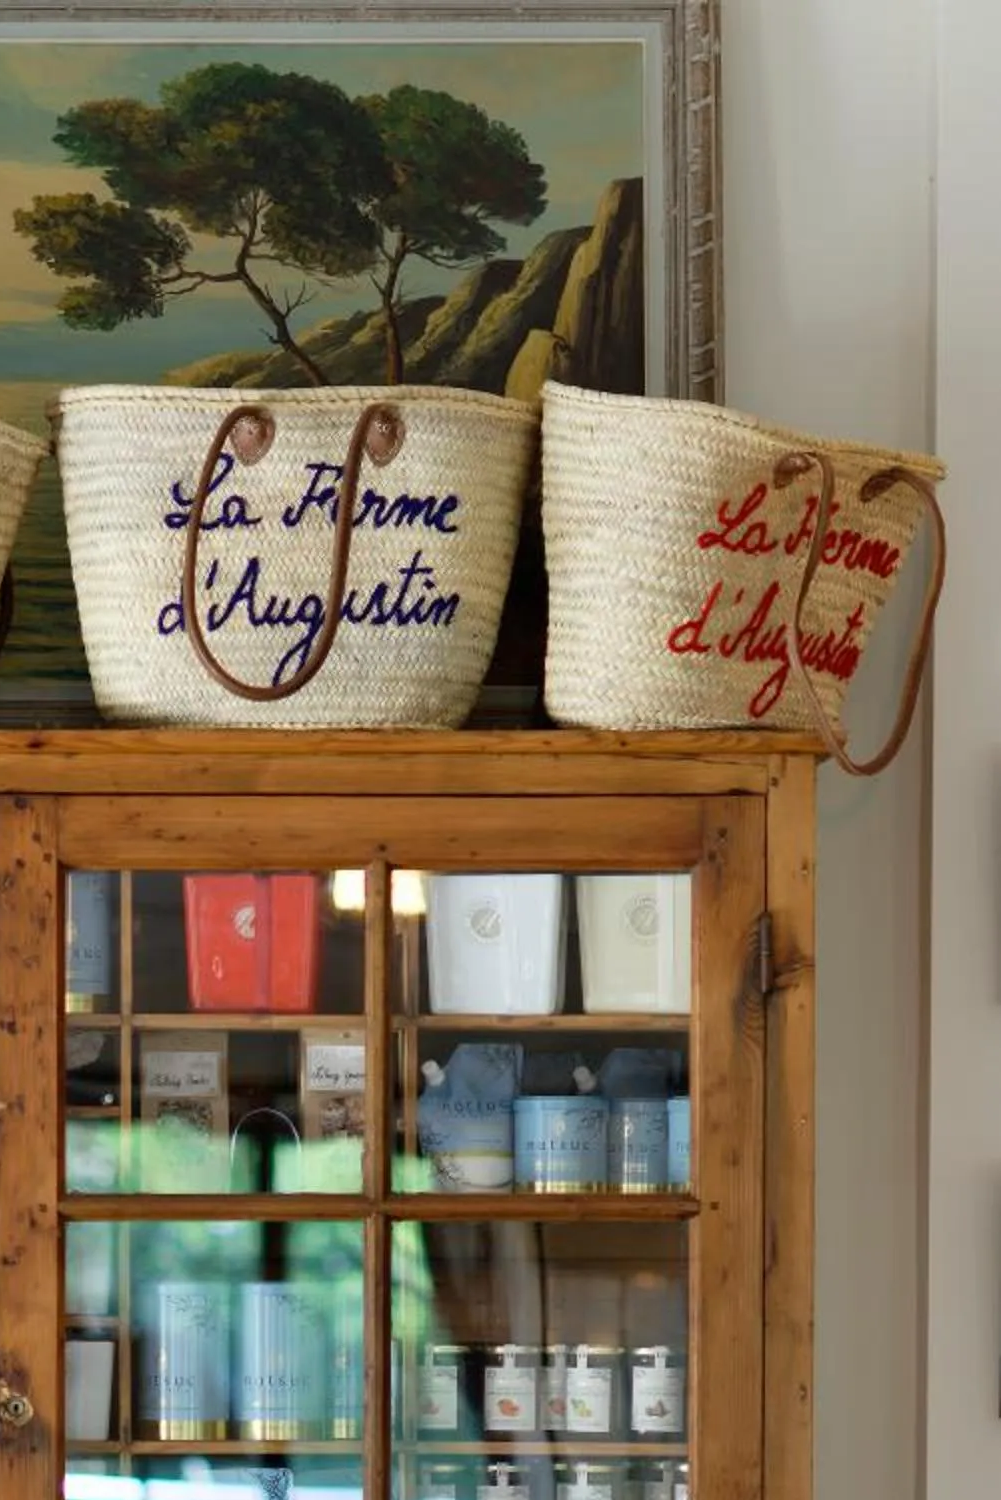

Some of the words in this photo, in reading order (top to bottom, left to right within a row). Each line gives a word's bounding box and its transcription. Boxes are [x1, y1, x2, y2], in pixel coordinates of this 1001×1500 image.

[163, 451, 264, 531] La
[698, 481, 778, 556] La
[784, 495, 900, 579] Ferme
[157, 549, 461, 688] d'Augustin
